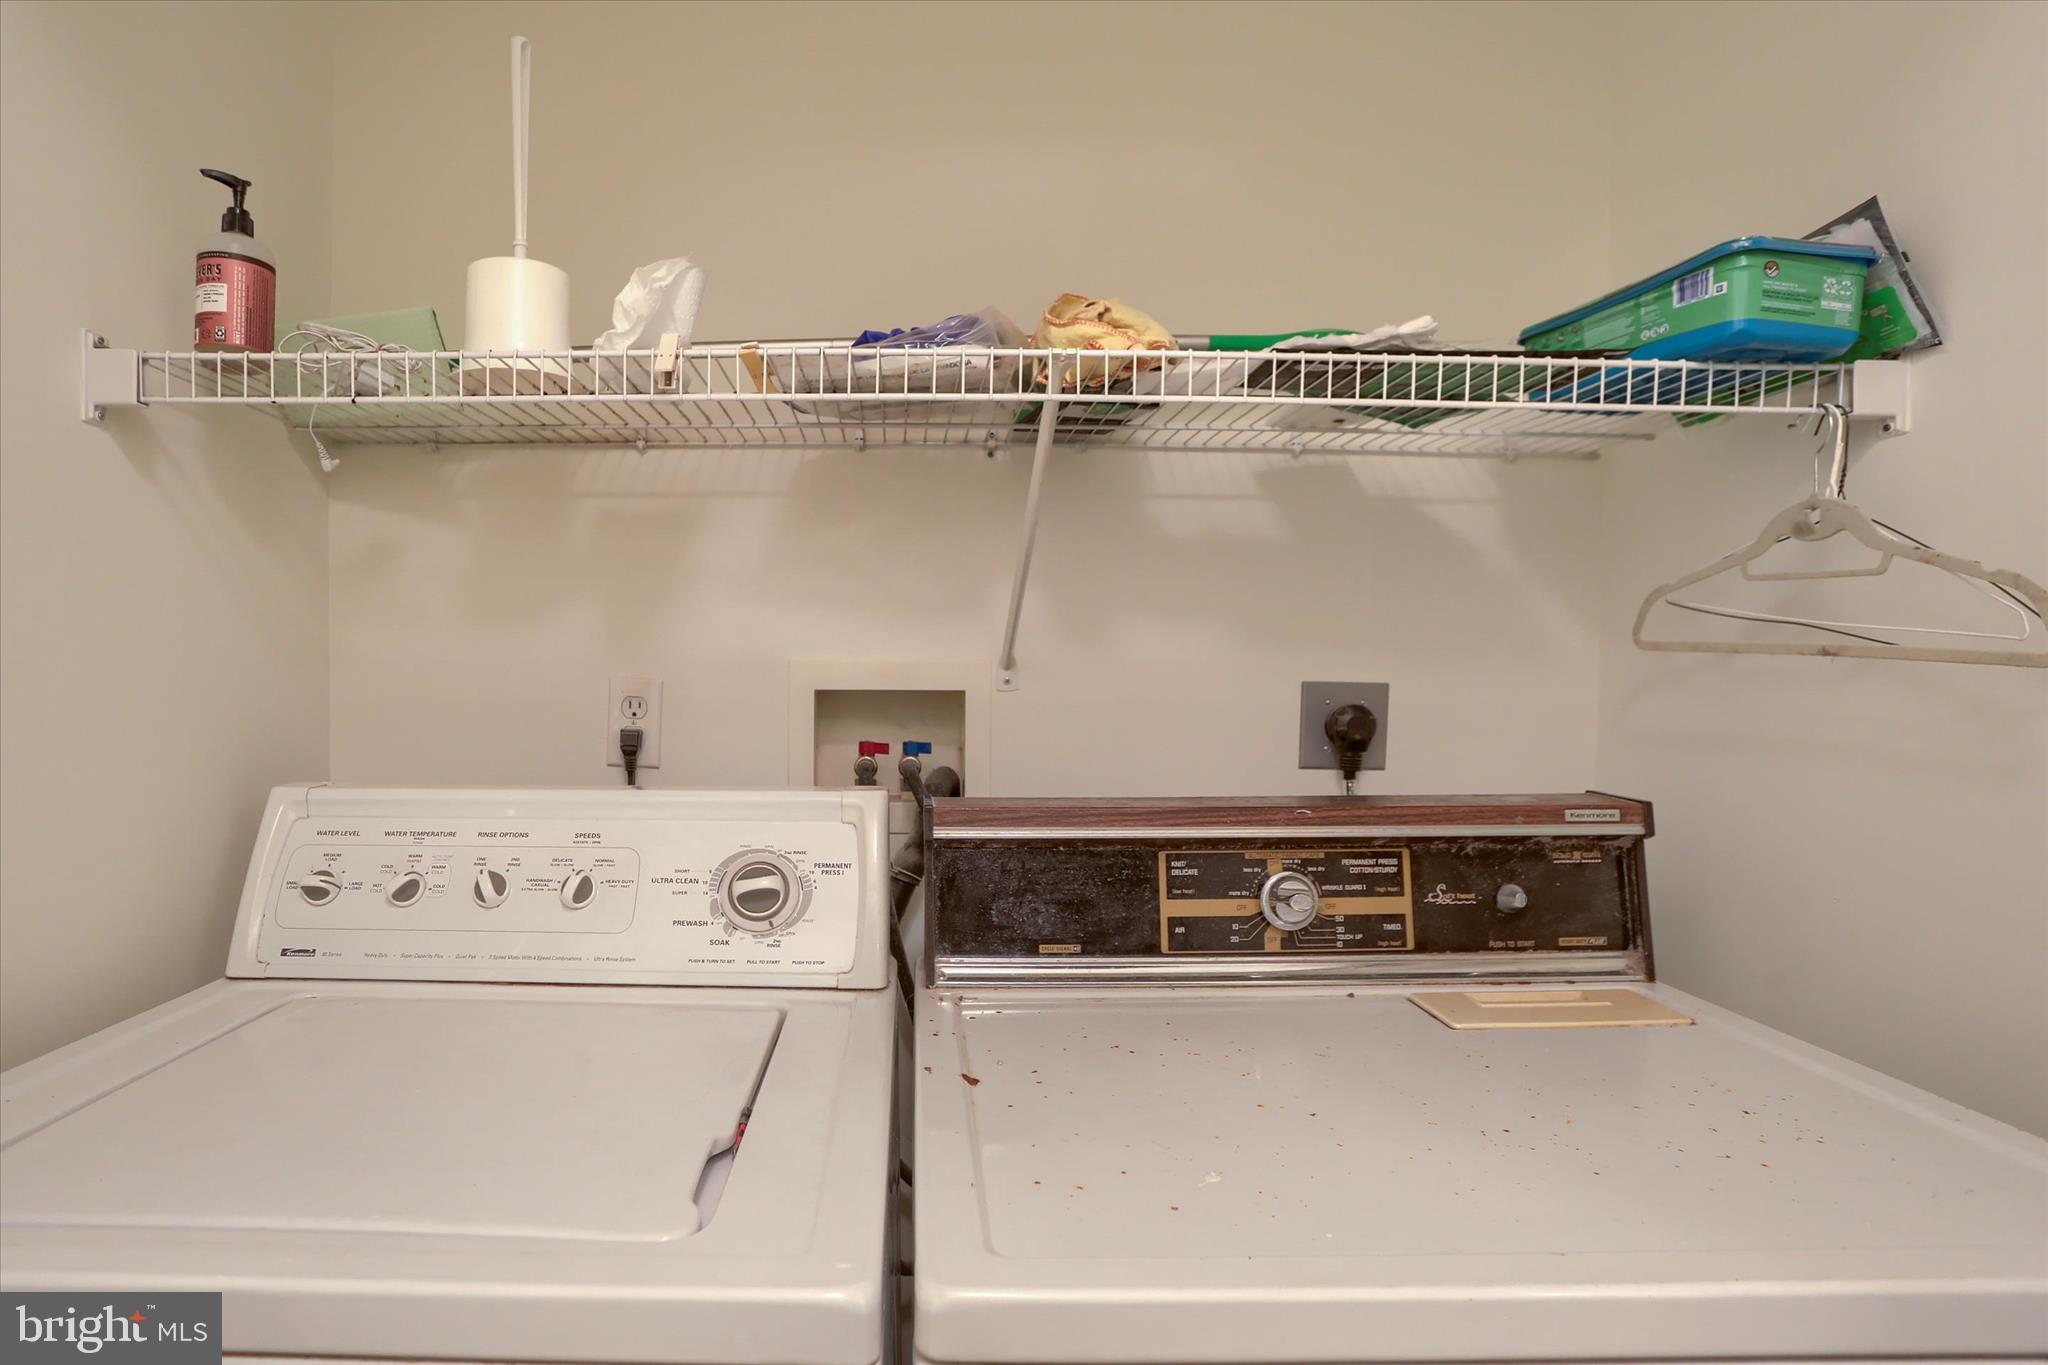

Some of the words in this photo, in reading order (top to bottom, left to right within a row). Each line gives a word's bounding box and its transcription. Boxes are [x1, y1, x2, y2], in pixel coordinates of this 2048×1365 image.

[1175, 926, 1186, 934] AIR
[1488, 940, 1506, 948] PUSH
[1506, 940, 1516, 948] TO
